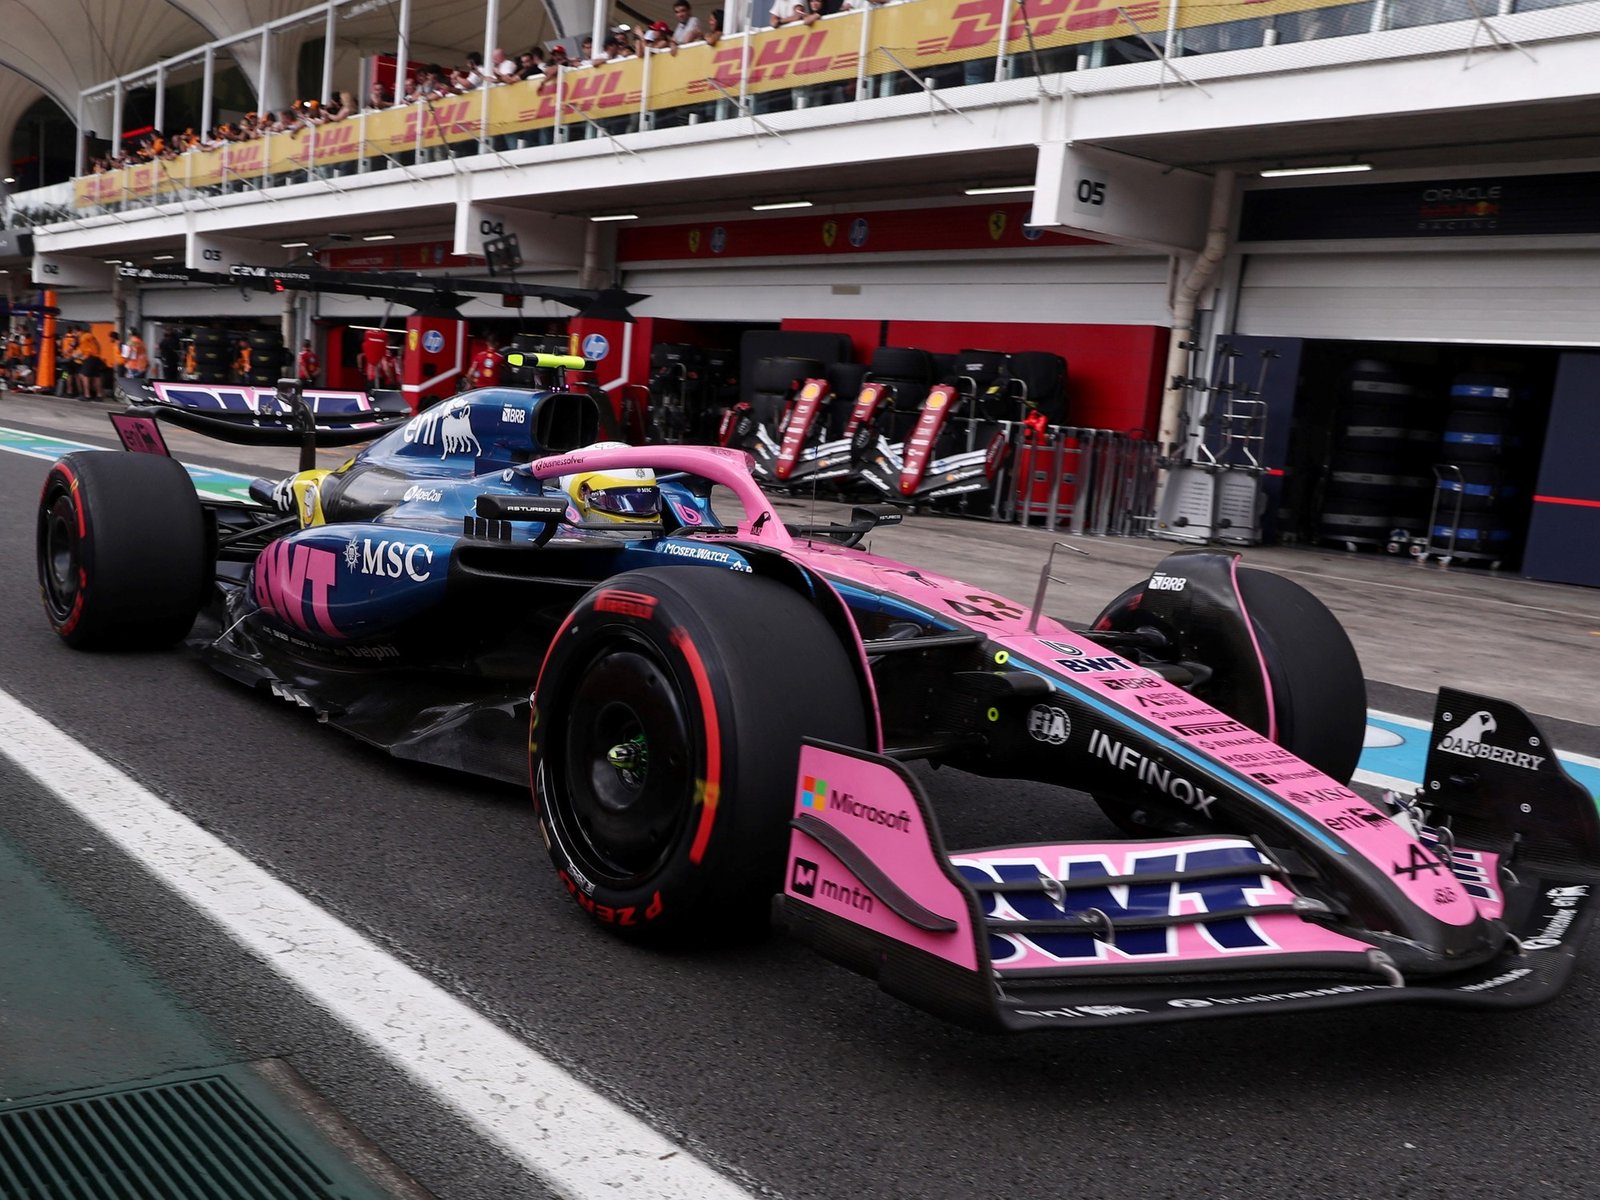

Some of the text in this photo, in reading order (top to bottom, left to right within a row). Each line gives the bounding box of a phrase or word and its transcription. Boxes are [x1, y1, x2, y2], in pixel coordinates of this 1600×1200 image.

[711, 30, 834, 90] DHL
[536, 71, 625, 120] DHL
[402, 101, 473, 143] DHL
[301, 126, 356, 160] DHL
[1078, 179, 1106, 206] 05
[1422, 186, 1502, 201] ORACLE
[203, 249, 221, 261] 03
[42, 263, 59, 275] 02
[403, 406, 441, 446] eni
[509, 408, 526, 424] BRB
[542, 455, 587, 470] businessolver
[361, 538, 433, 582] MSC
[254, 537, 347, 639] BWT
[1159, 577, 1187, 592] BRB
[942, 595, 1024, 622] 43
[350, 643, 400, 661] Delphi
[1054, 656, 1133, 674] BWT
[1121, 677, 1163, 690] BRB
[1165, 708, 1220, 719] BINANCE
[1169, 720, 1248, 737] PIRELLI
[1213, 737, 1269, 748] BINANCE
[1220, 750, 1294, 764] MOBILIZE
[1441, 735, 1546, 771] OAKBERRY
[1087, 728, 1218, 819] INFINOX
[1302, 786, 1356, 803] MSC
[830, 789, 912, 834] Microsoft
[1324, 810, 1362, 832] eni
[820, 878, 875, 914] mntn
